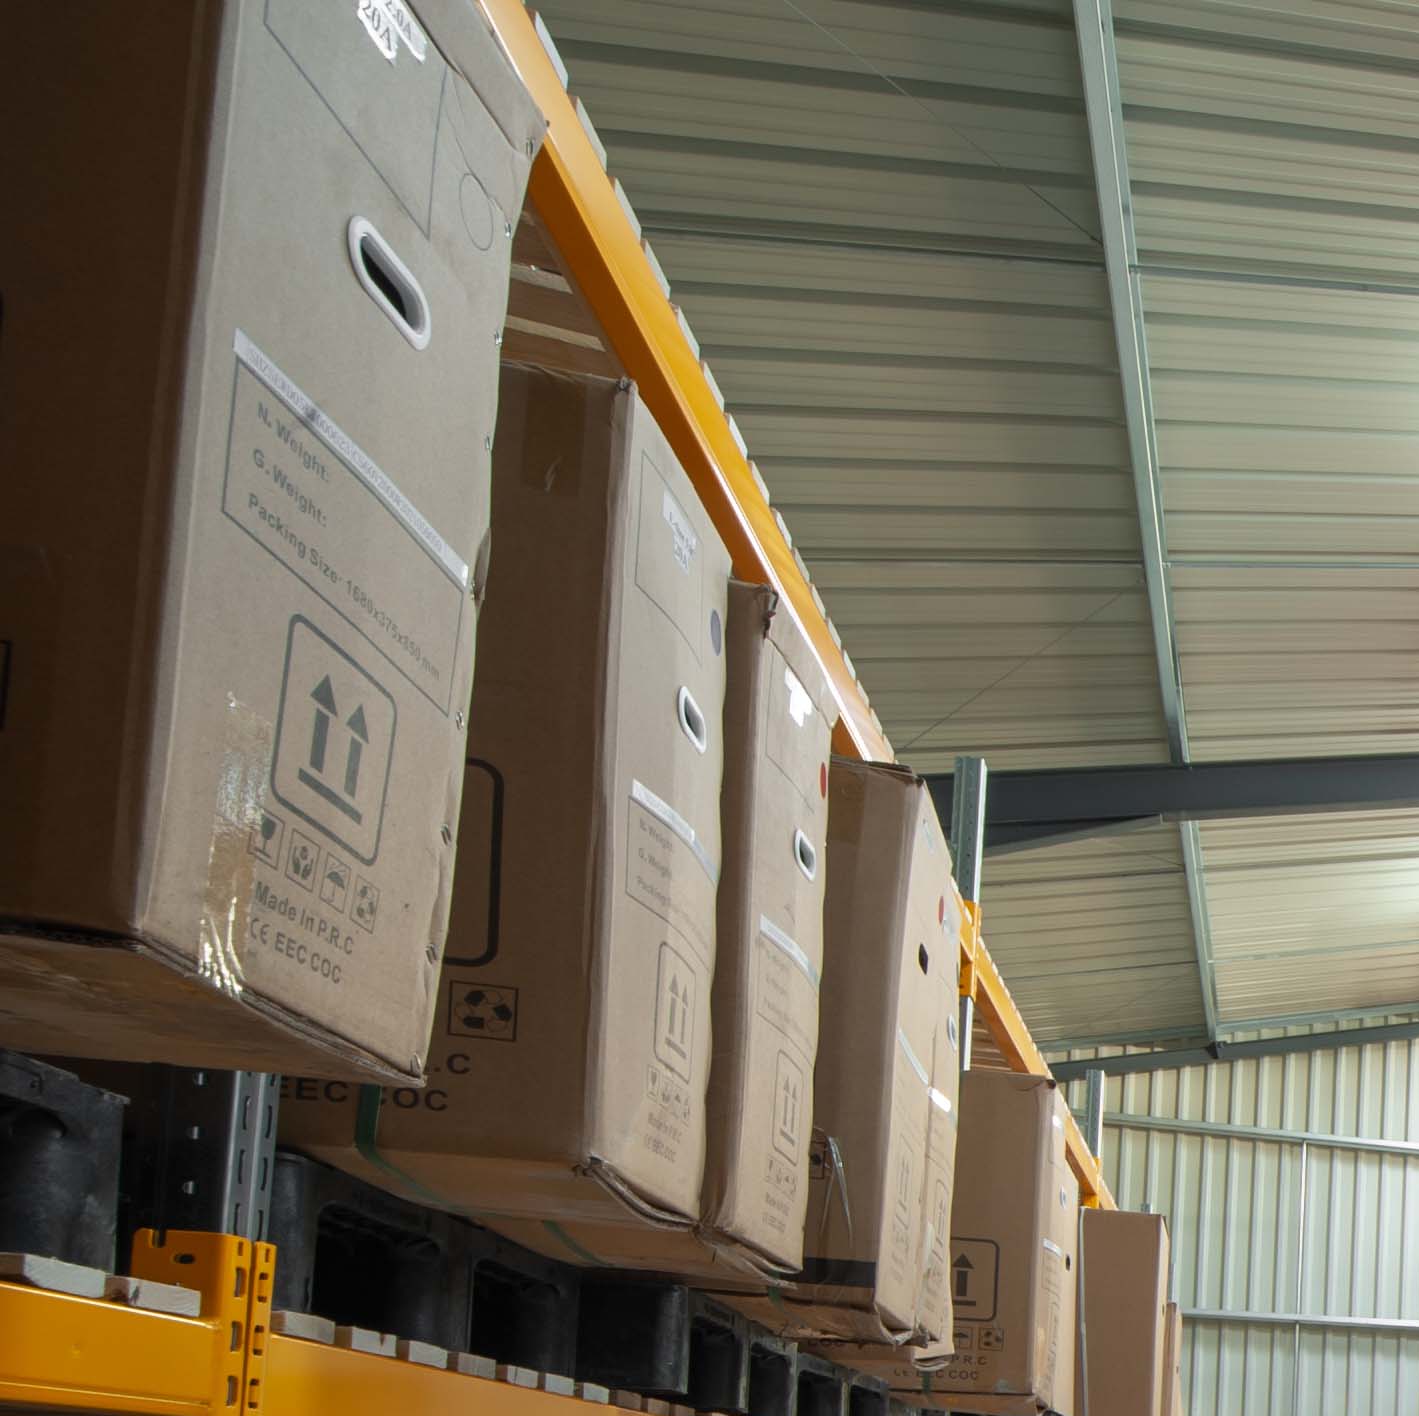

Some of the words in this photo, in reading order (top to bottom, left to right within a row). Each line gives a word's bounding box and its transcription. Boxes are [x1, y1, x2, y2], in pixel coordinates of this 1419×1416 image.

[253, 449, 270, 475] G.
[273, 465, 327, 527] Weight:
[248, 493, 306, 559] Packing
[255, 881, 297, 921] Made
[316, 920, 354, 956] P.R.C
[274, 930, 306, 966] EEC
[310, 953, 342, 985] COC
[380, 1086, 448, 1112] OC
